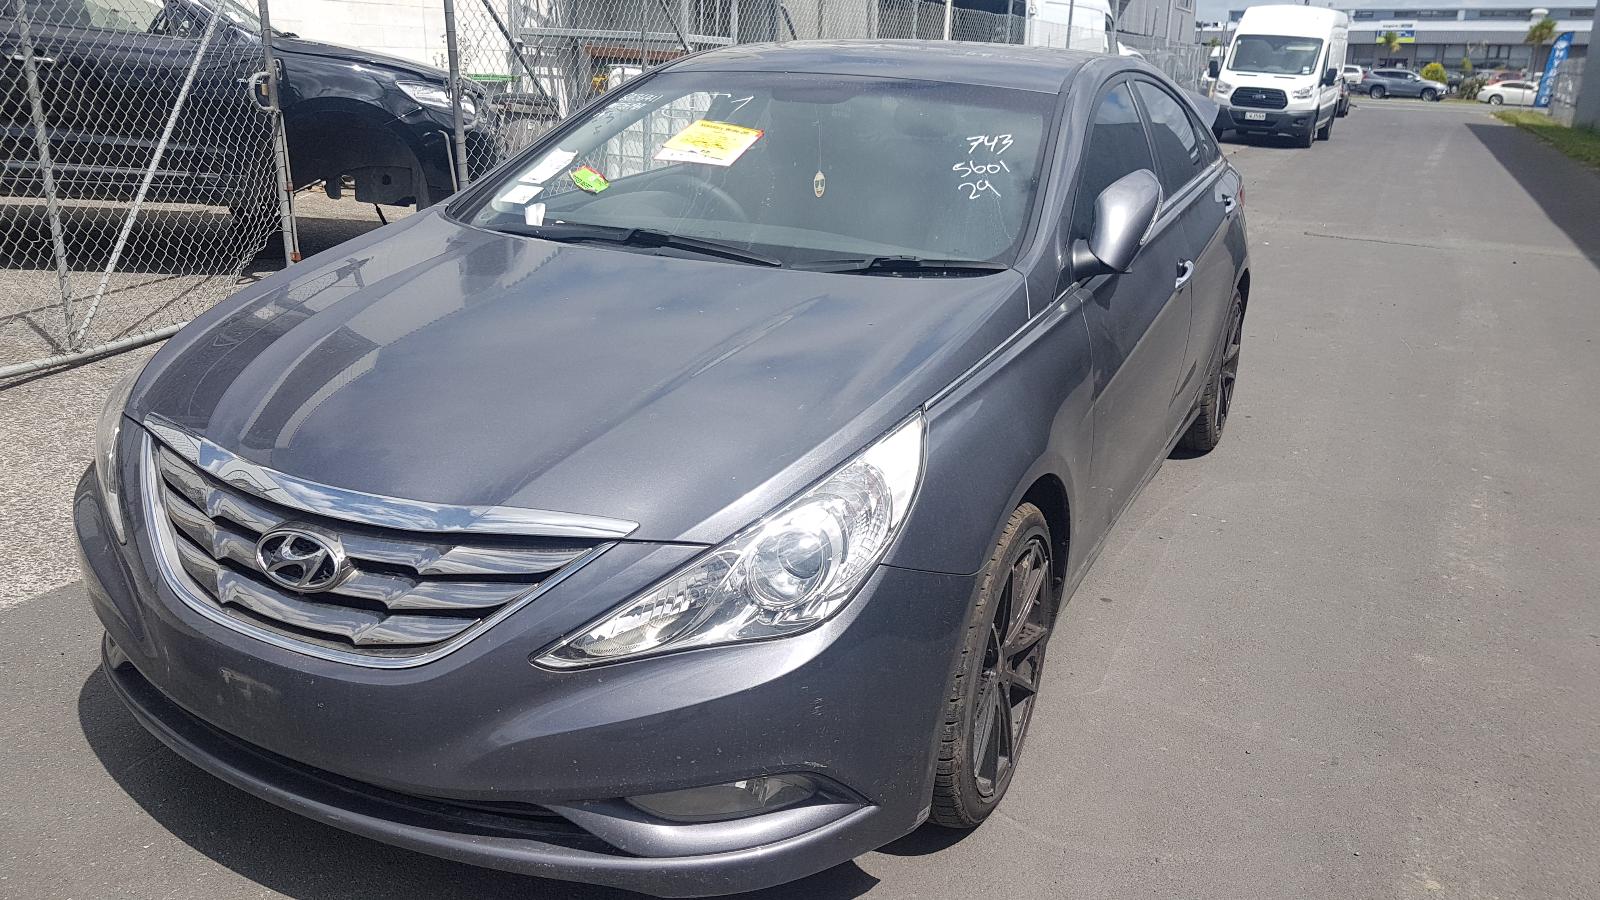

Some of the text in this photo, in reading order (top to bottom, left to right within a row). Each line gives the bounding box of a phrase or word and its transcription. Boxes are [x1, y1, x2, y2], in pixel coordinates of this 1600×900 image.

[966, 134, 1013, 154] 743
[953, 160, 1010, 177] 5601
[958, 180, 1001, 199] 29
